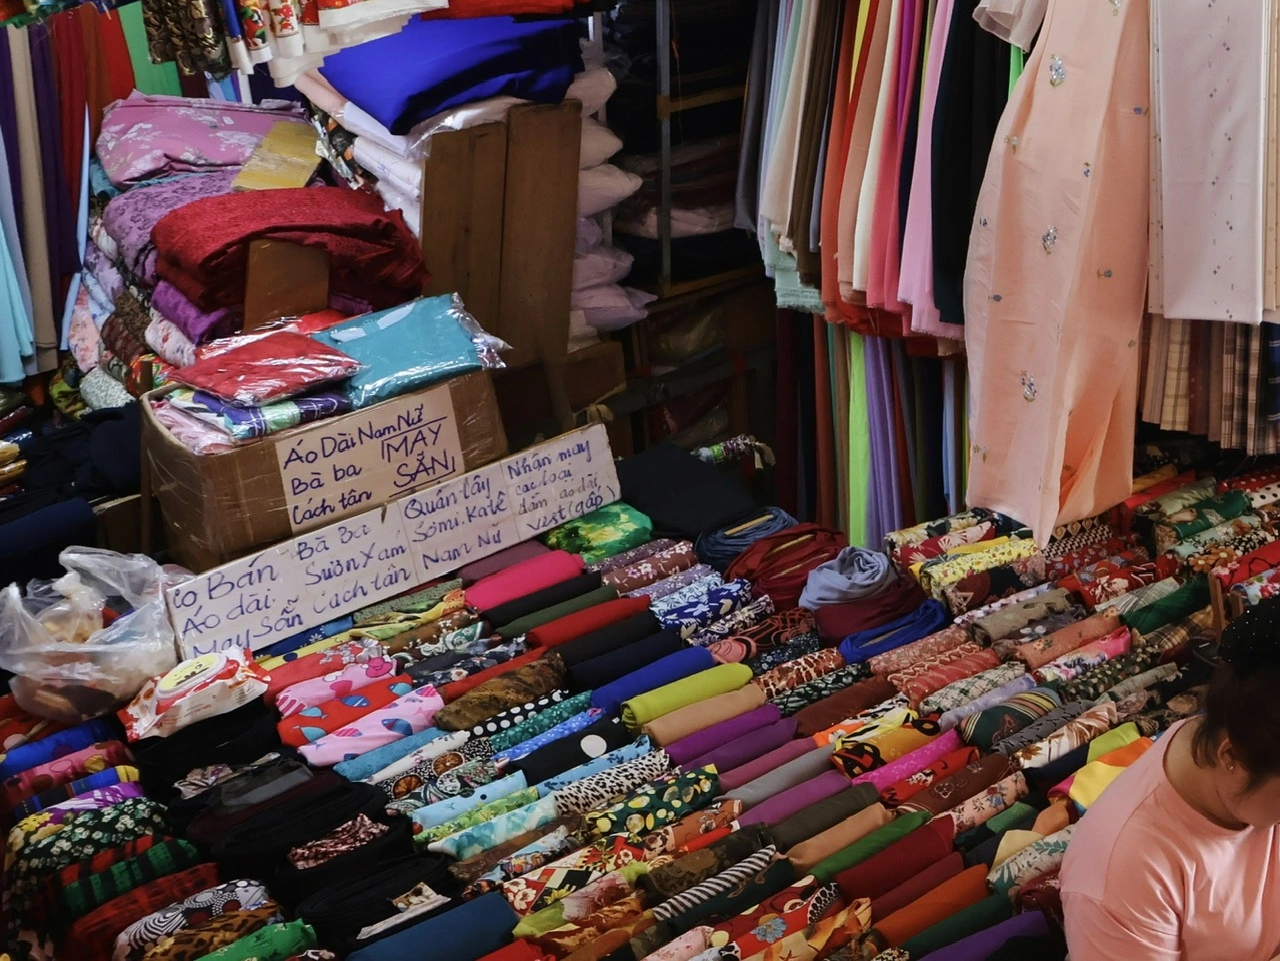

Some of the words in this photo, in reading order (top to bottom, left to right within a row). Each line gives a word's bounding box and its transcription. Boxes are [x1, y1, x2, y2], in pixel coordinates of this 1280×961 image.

[284, 439, 318, 470] Áo
[358, 421, 397, 445] Nam
[386, 424, 442, 463] MAY
[333, 464, 362, 482] ba
[339, 489, 373, 509] tân
[422, 543, 472, 570] Nam
